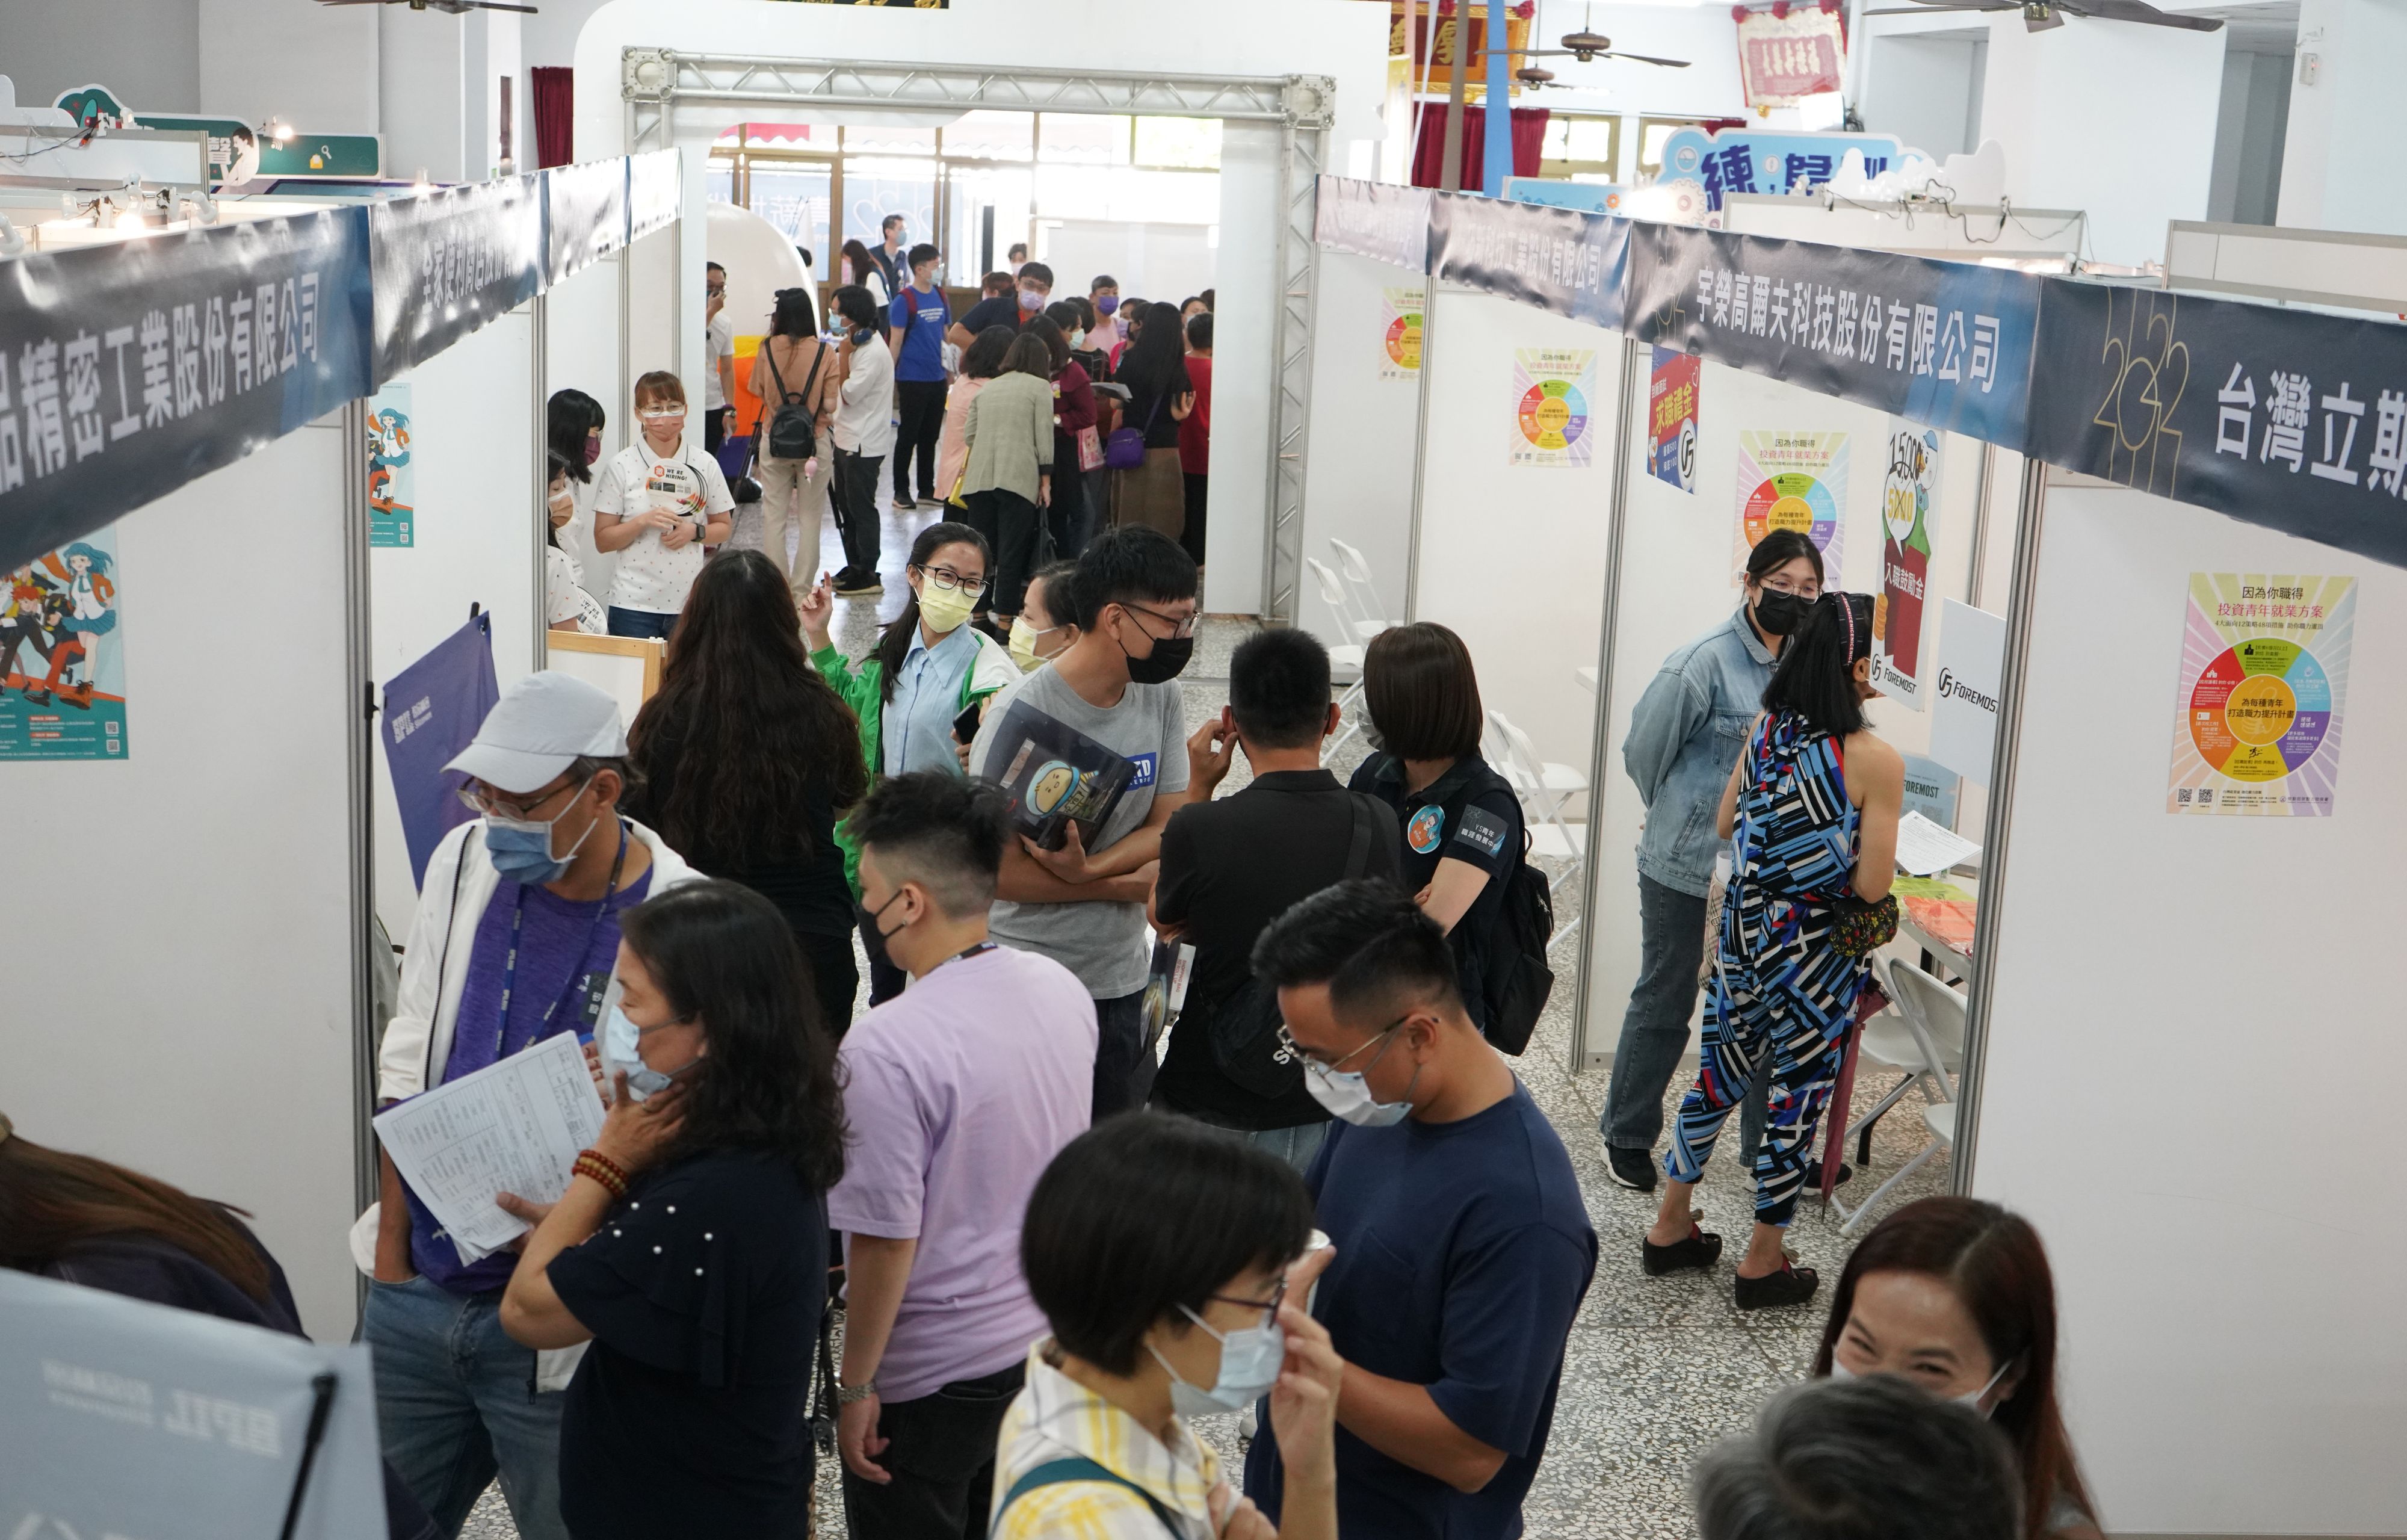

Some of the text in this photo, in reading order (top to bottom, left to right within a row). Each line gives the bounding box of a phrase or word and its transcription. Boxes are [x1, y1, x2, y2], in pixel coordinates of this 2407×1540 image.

[1696, 266, 2001, 394] 宇榮高爾夫科技股份有限公司
[1656, 382, 1693, 434] 求職禮金
[1775, 439, 1815, 448] 因為你職得
[1760, 450, 1829, 460] 投資青年就業方案
[1884, 562, 1924, 601] 入職鼓勵金
[2242, 586, 2304, 600] 因為你職得
[2217, 603, 2323, 619] 投資青年就業方案
[1884, 668, 1917, 696] FOREMOST
[1953, 681, 1998, 714] FOREMOS
[2242, 698, 2284, 708] 為每種青年
[2227, 709, 2294, 719] 打造職力提升計畫
[1475, 823, 1496, 838] YS青年
